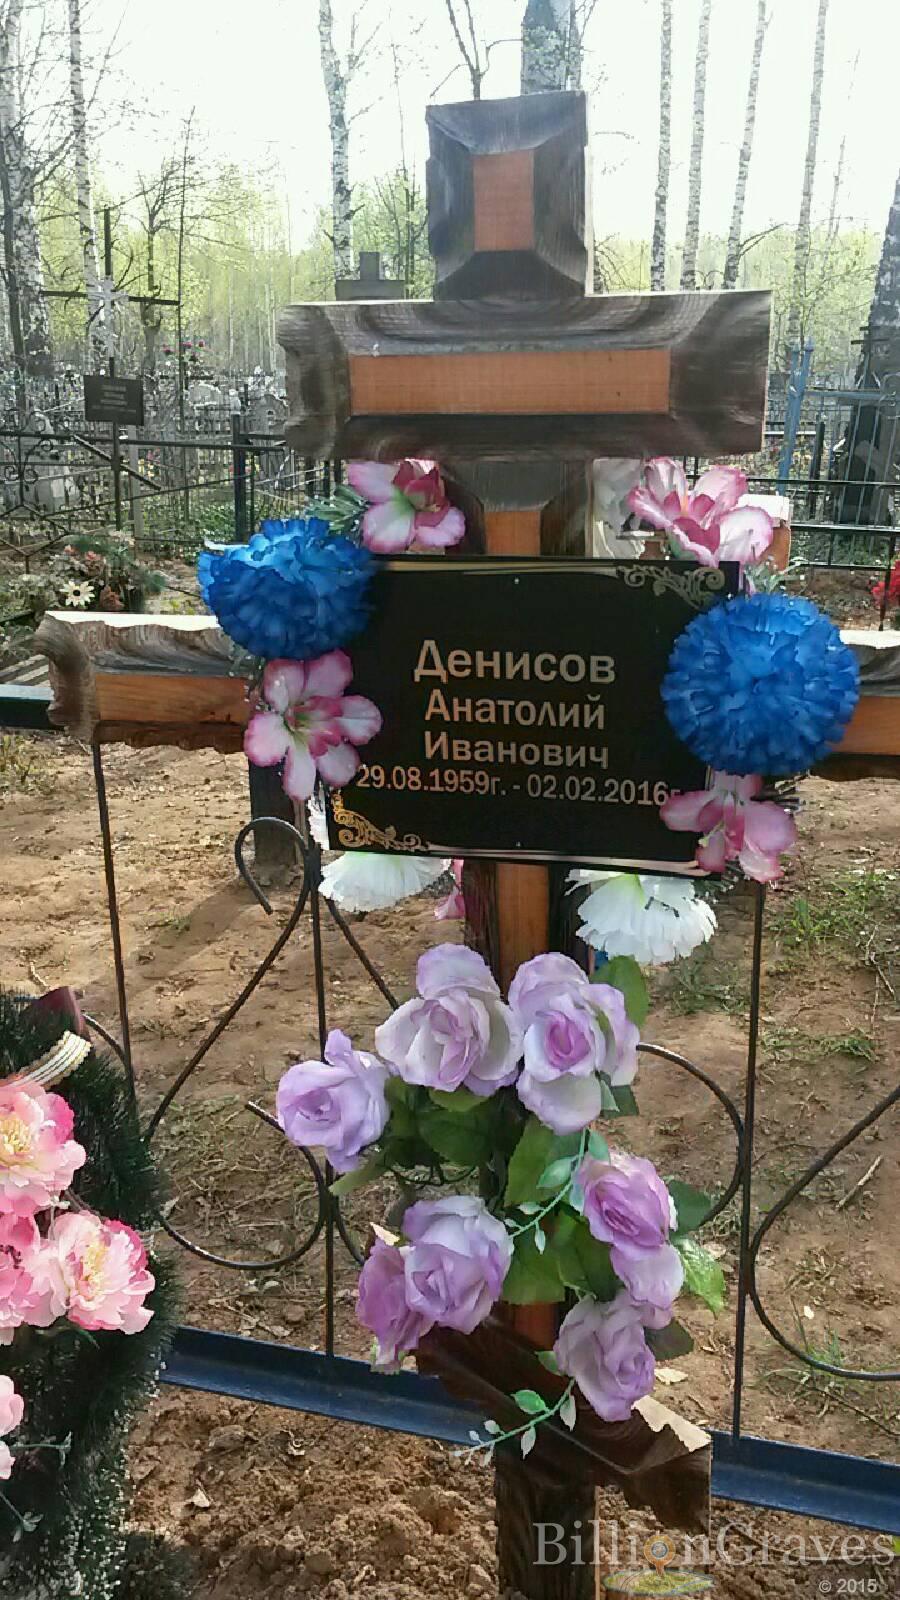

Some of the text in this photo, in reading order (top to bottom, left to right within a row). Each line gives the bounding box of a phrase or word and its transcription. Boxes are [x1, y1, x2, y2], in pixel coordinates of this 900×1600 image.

[413, 639, 616, 684] Денисов
[424, 688, 606, 731] Анатолий
[424, 731, 609, 770] Иванович
